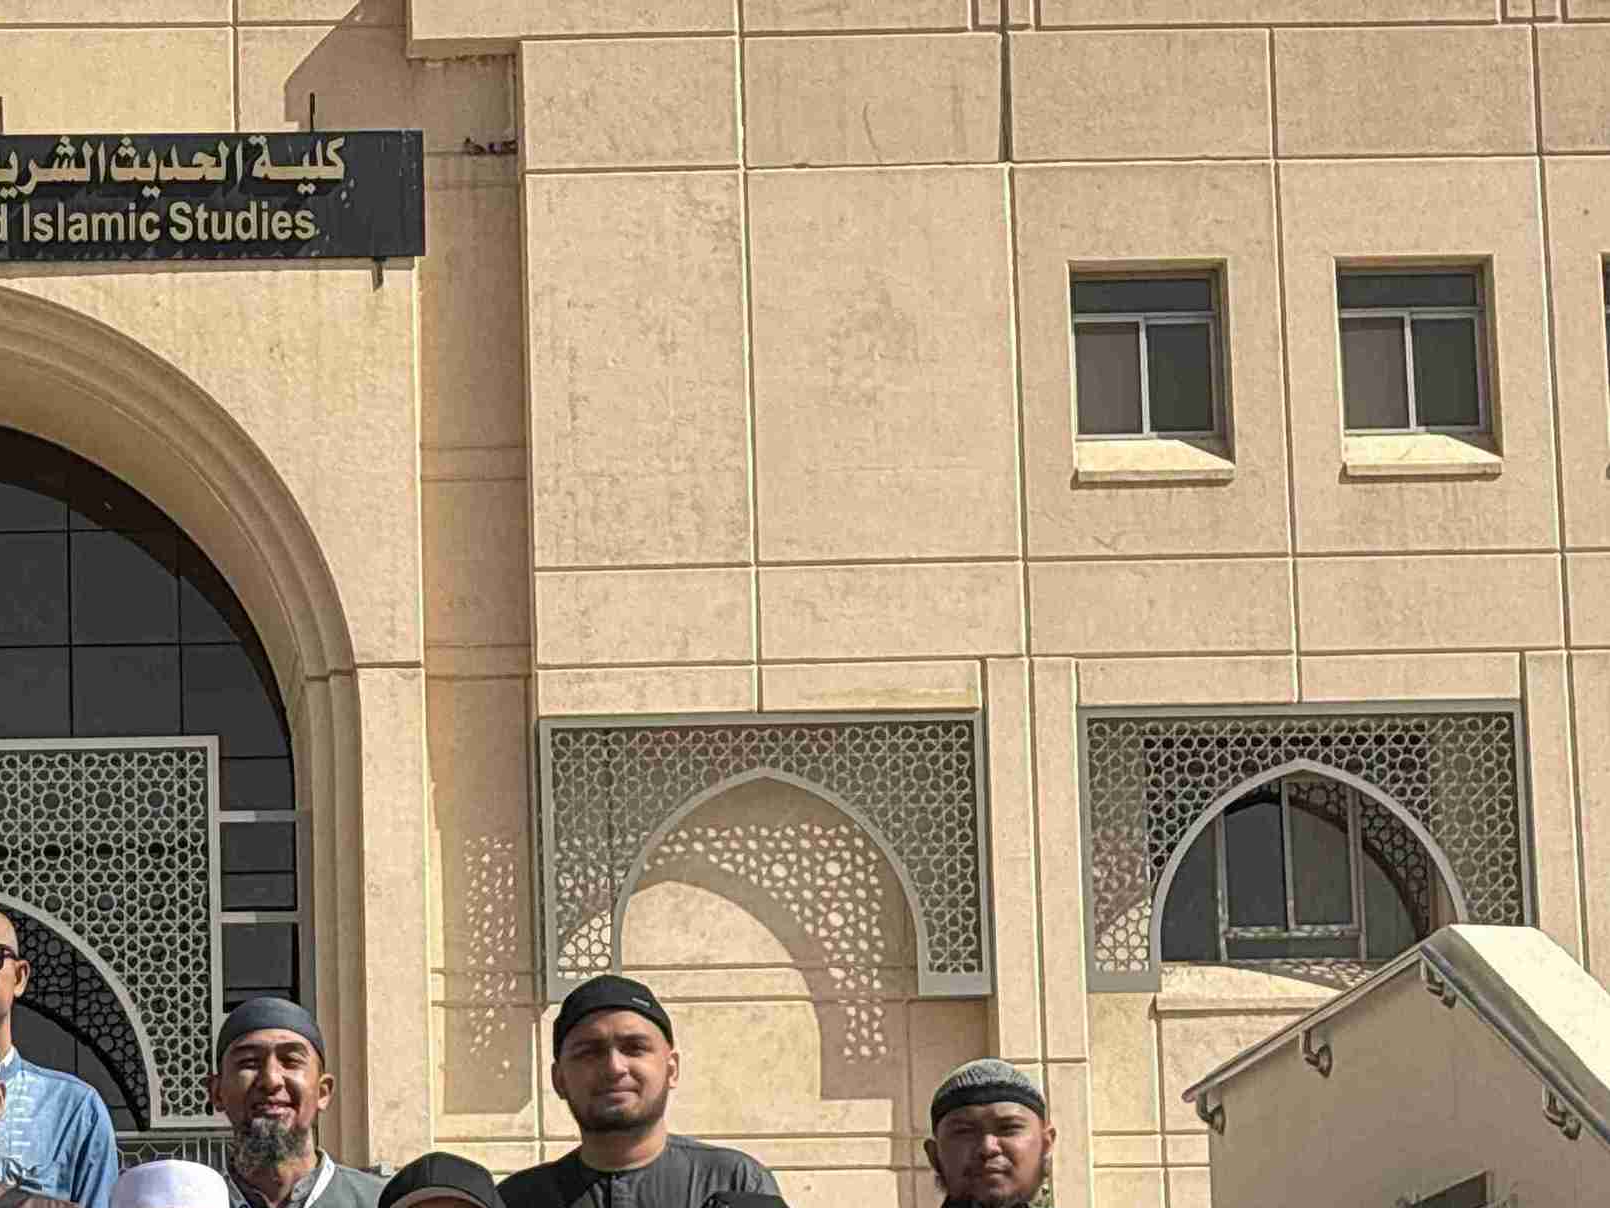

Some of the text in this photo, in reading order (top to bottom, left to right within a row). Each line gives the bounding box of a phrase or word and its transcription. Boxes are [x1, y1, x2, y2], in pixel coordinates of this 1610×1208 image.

[110, 136, 244, 198] الحديث
[250, 135, 346, 196] كلية
[21, 201, 161, 243] Islamic
[168, 200, 316, 242] Studies
